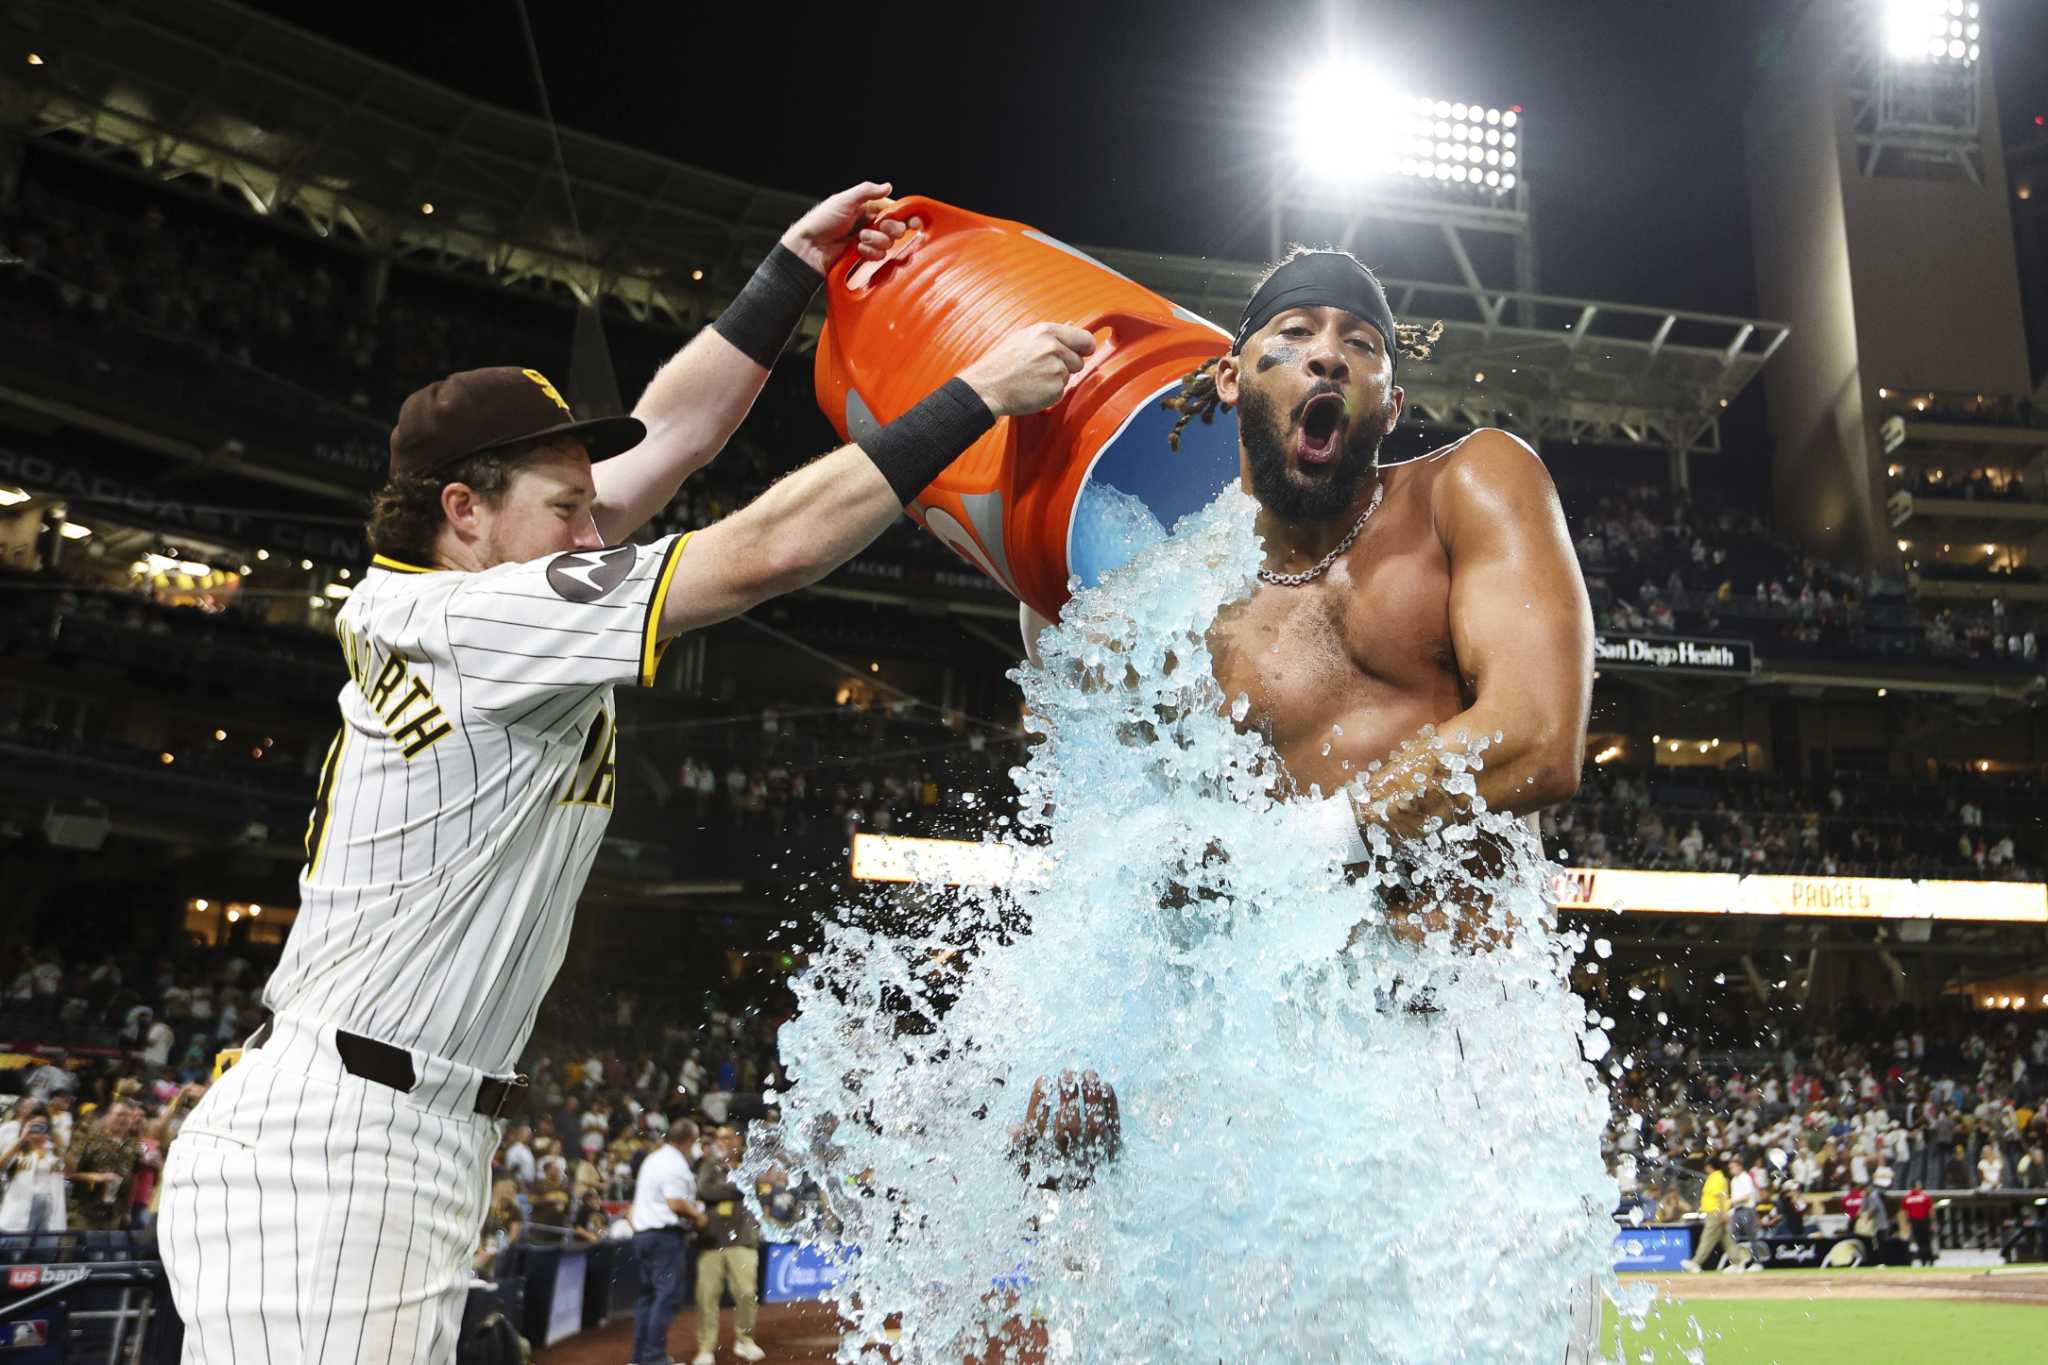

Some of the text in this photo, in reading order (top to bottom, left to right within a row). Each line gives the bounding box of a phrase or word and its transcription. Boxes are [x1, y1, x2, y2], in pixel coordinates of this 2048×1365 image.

[1595, 637, 1734, 667] San Diego Health
[1792, 880, 1871, 909] PADRES
